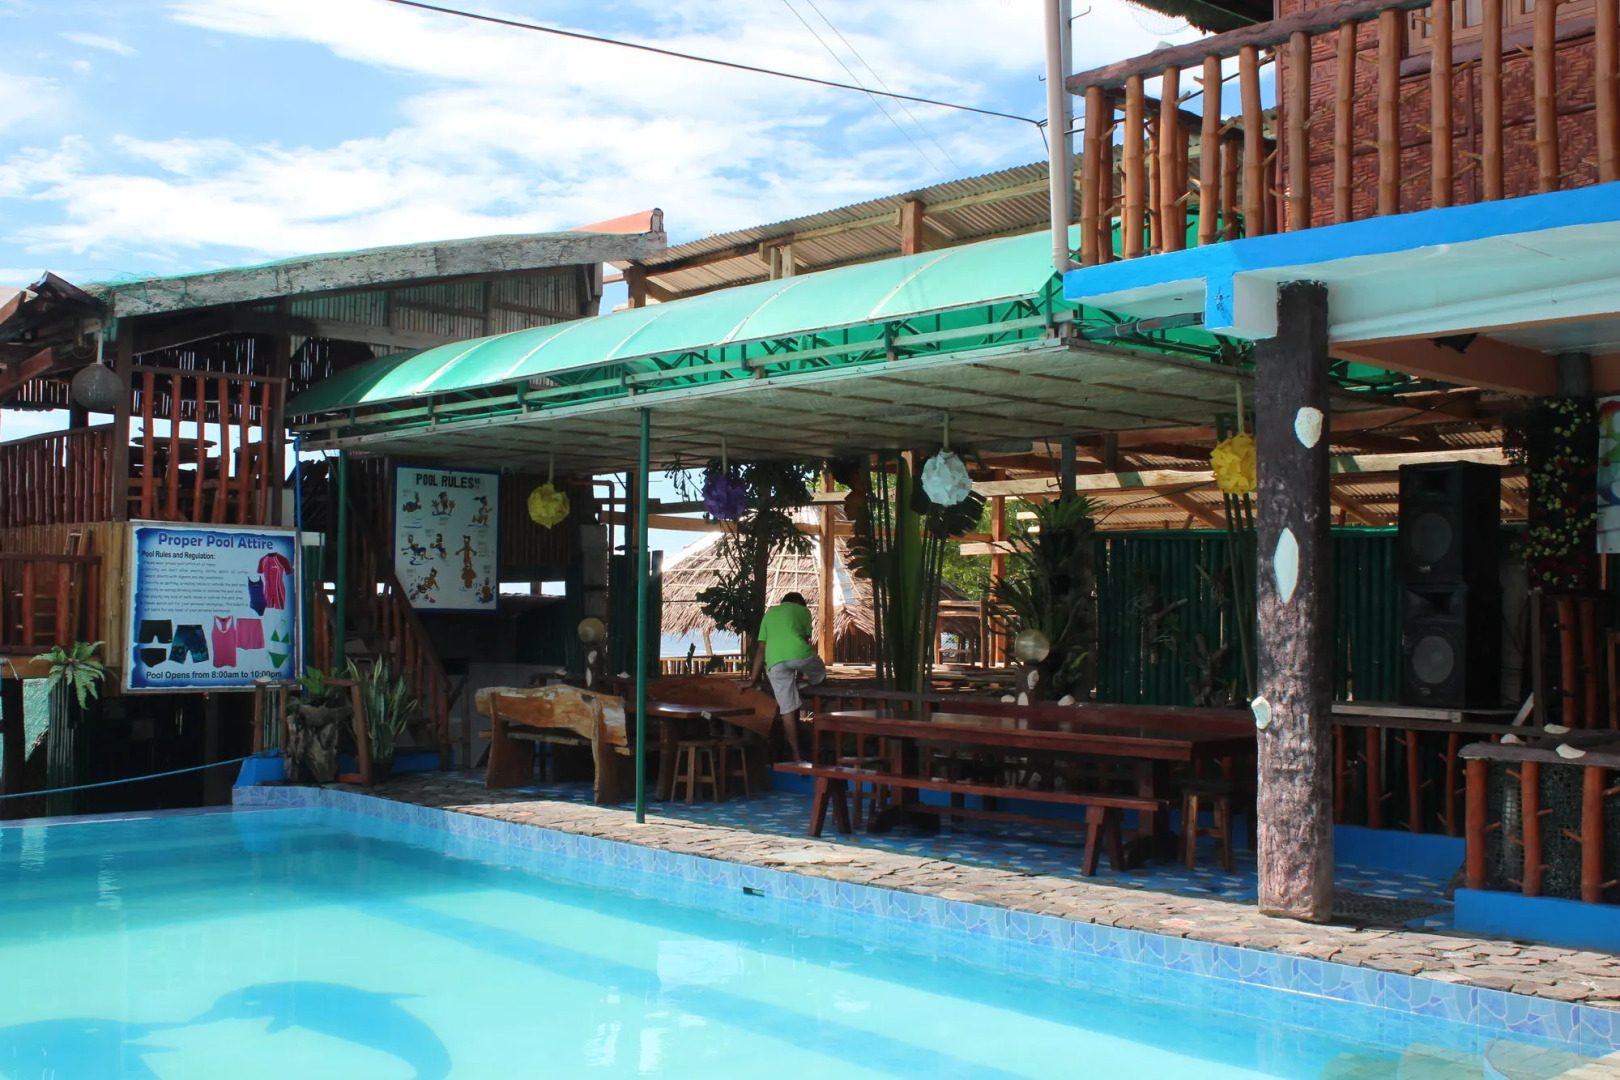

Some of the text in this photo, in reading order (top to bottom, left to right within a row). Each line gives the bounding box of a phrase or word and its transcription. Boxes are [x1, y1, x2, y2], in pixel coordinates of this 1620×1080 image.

[416, 473, 438, 486] POOL
[158, 532, 273, 550] Proper Pool Attire
[141, 550, 154, 558] Pool
[155, 551, 171, 559] Rules
[146, 671, 163, 679] Pool
[165, 671, 190, 680] Opens
[192, 671, 210, 679] from
[211, 671, 238, 679] 8:00am
